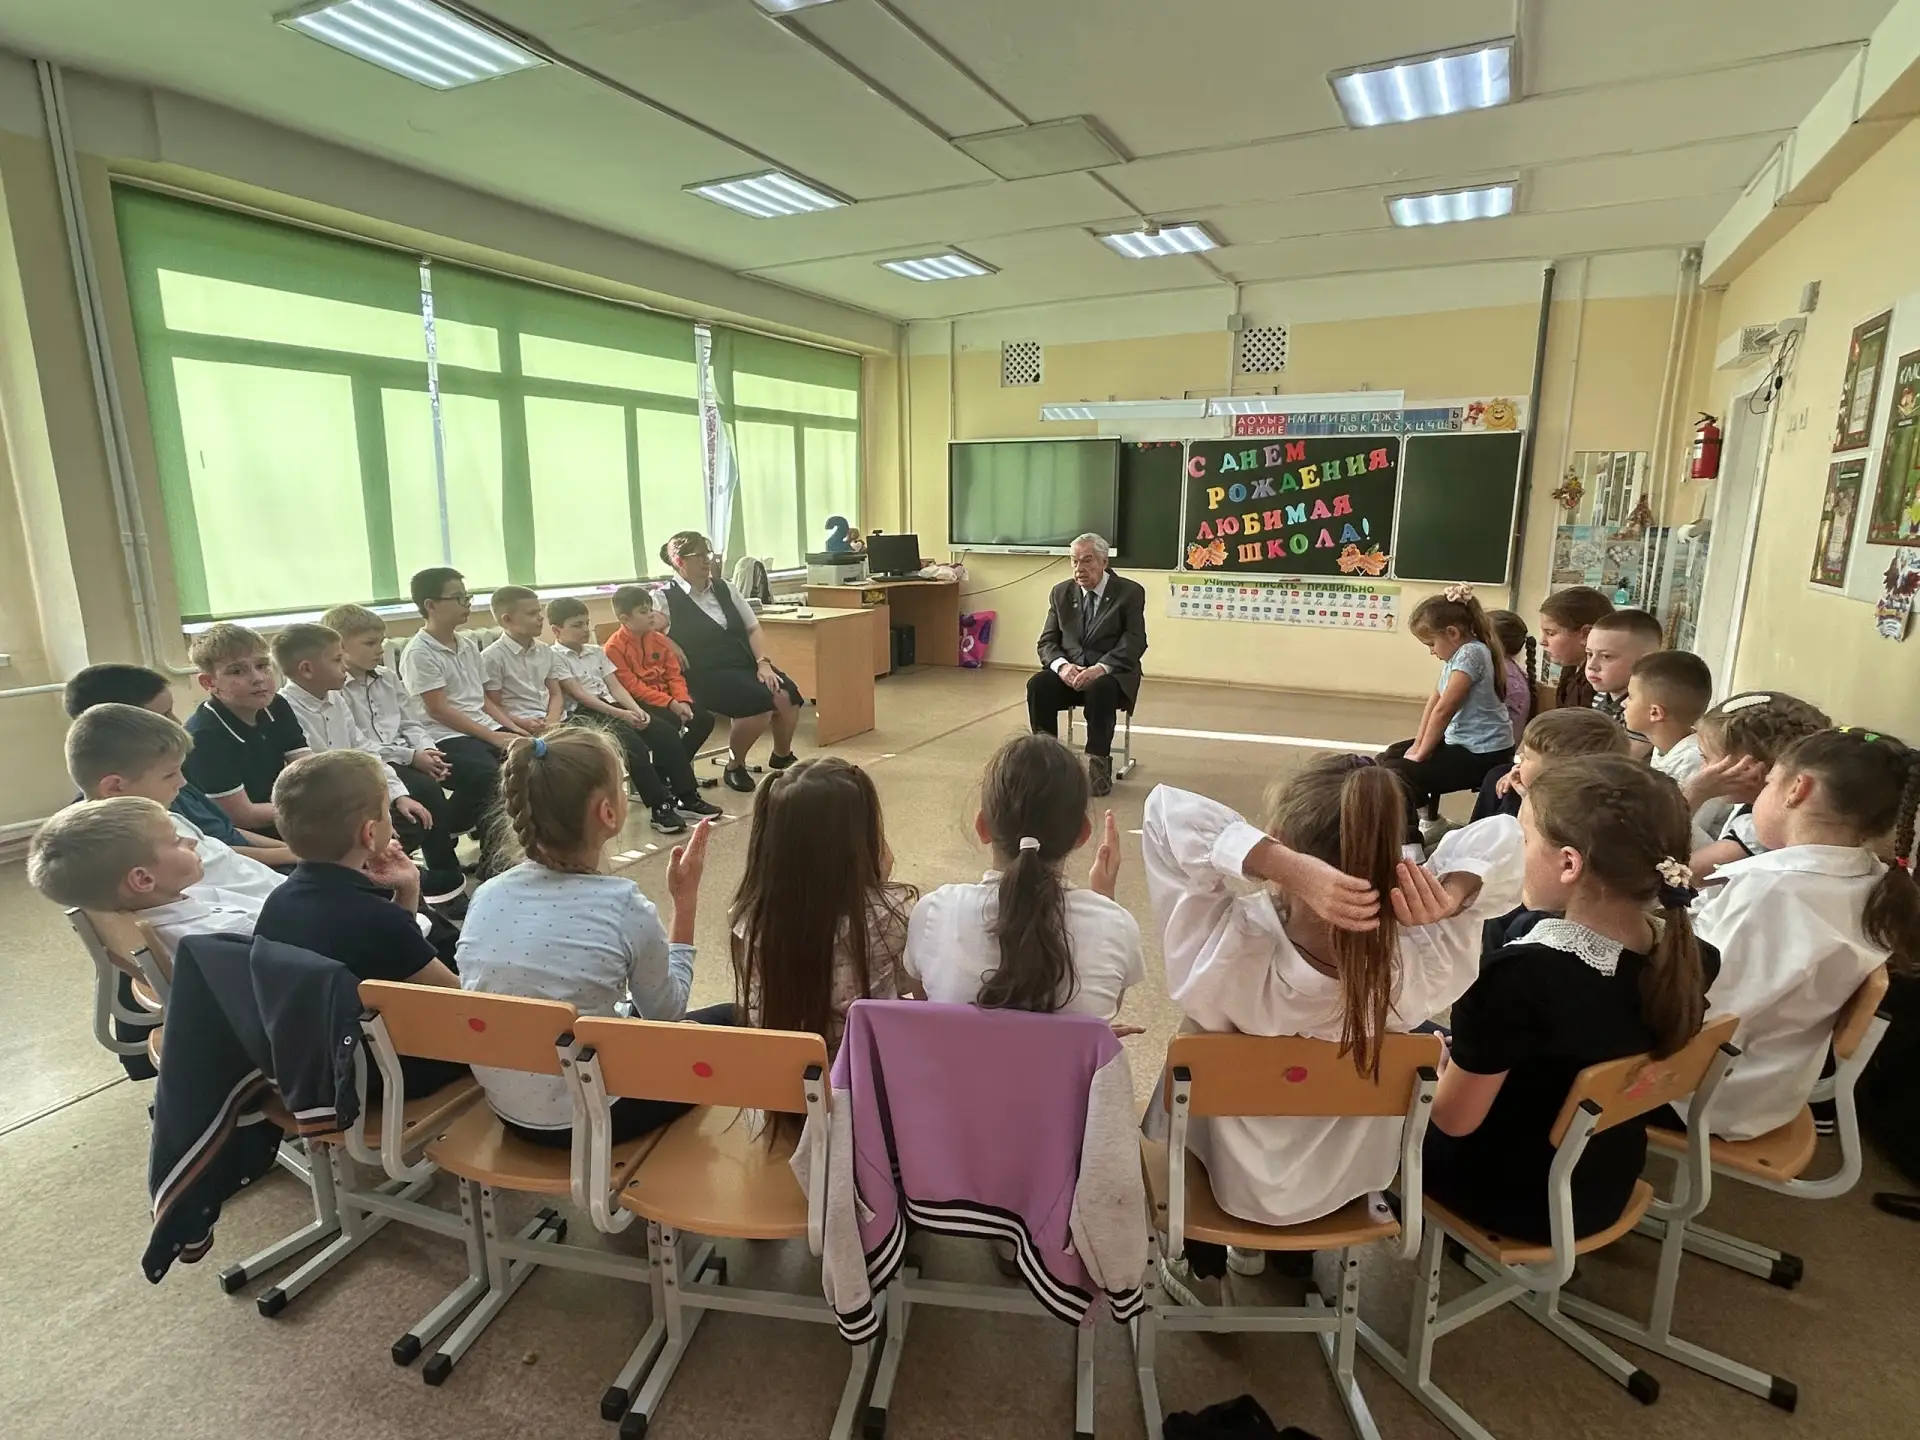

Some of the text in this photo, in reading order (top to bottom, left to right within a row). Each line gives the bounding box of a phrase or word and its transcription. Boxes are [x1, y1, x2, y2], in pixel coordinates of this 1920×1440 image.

[1188, 440, 1306, 477] С ДНЕМ
[1206, 448, 1395, 509] РОЖДЕНИЯ,
[1196, 494, 1353, 540] ЛЮБИМАЯ
[1237, 517, 1371, 563] ШКОЛА!
[1306, 582, 1375, 594] ПРАВИЛЬНО
